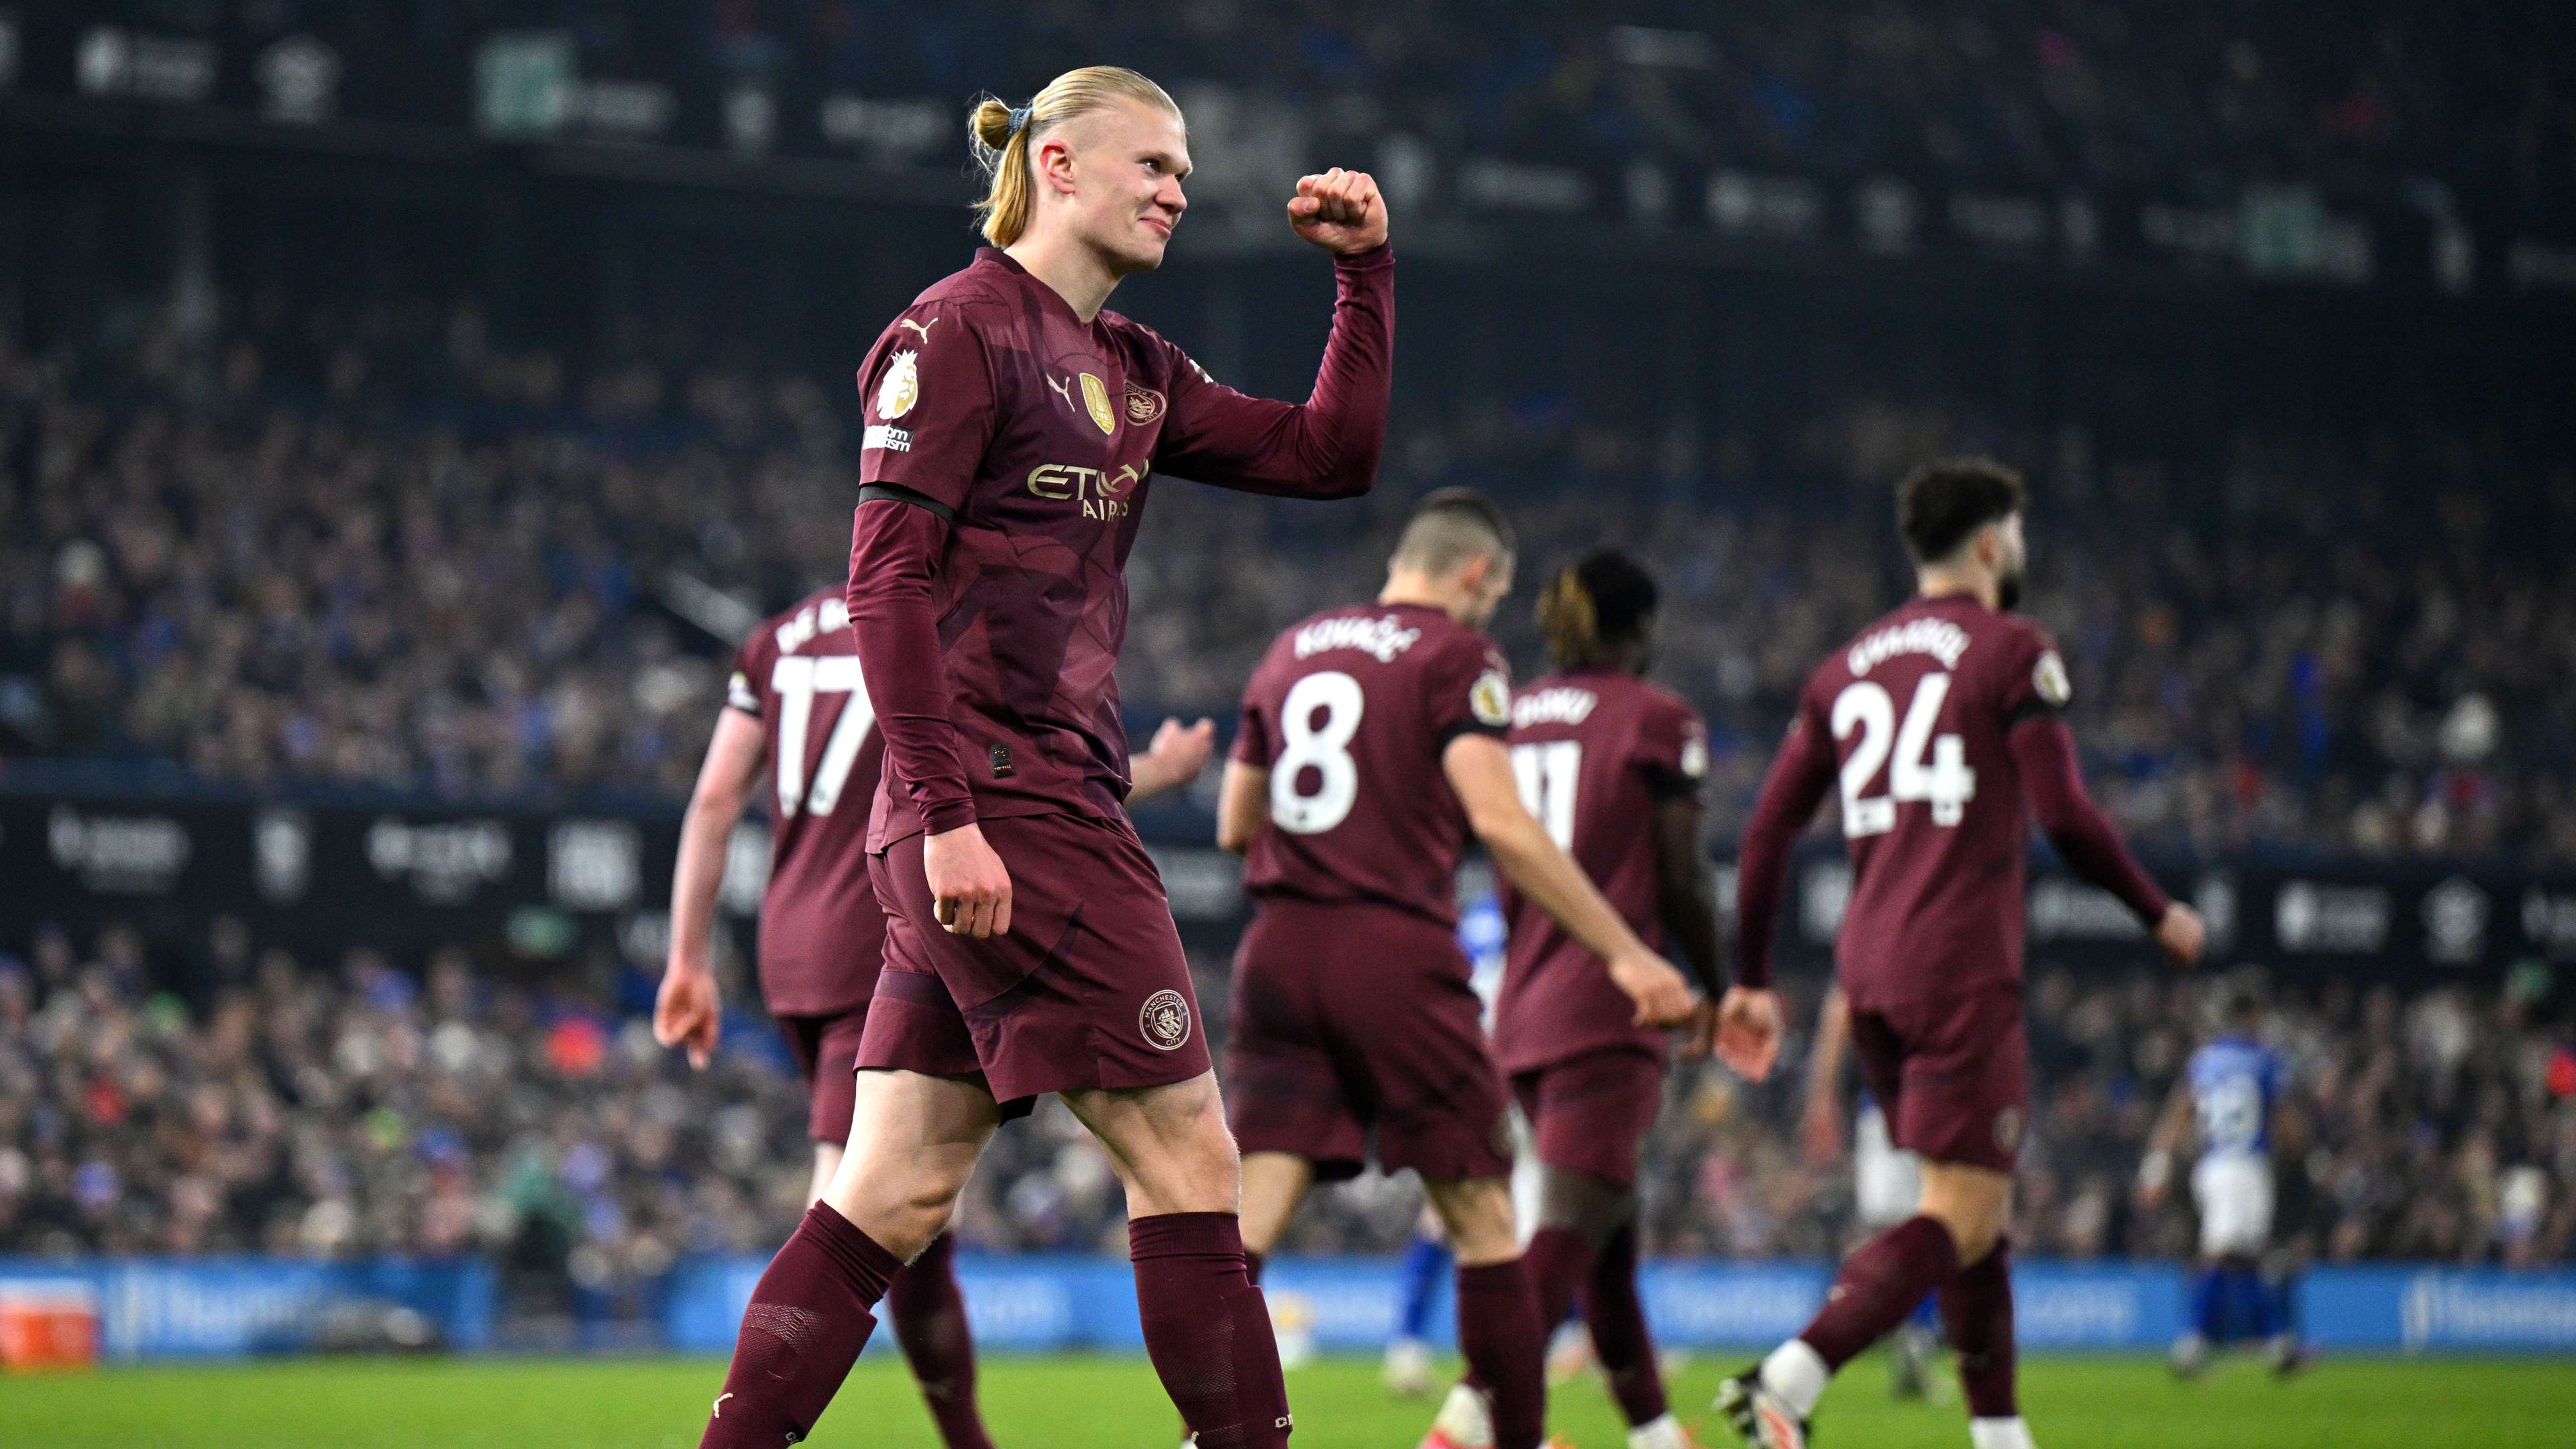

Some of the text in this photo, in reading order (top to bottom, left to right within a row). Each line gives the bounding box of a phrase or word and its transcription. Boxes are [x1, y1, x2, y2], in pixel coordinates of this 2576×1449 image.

[771, 655, 876, 818] 17
[1270, 669, 1365, 835] 8
[1831, 672, 1976, 839] 24
[1144, 994, 1183, 1018] MANCHESTER
[1165, 1036, 1181, 1046] CITY
